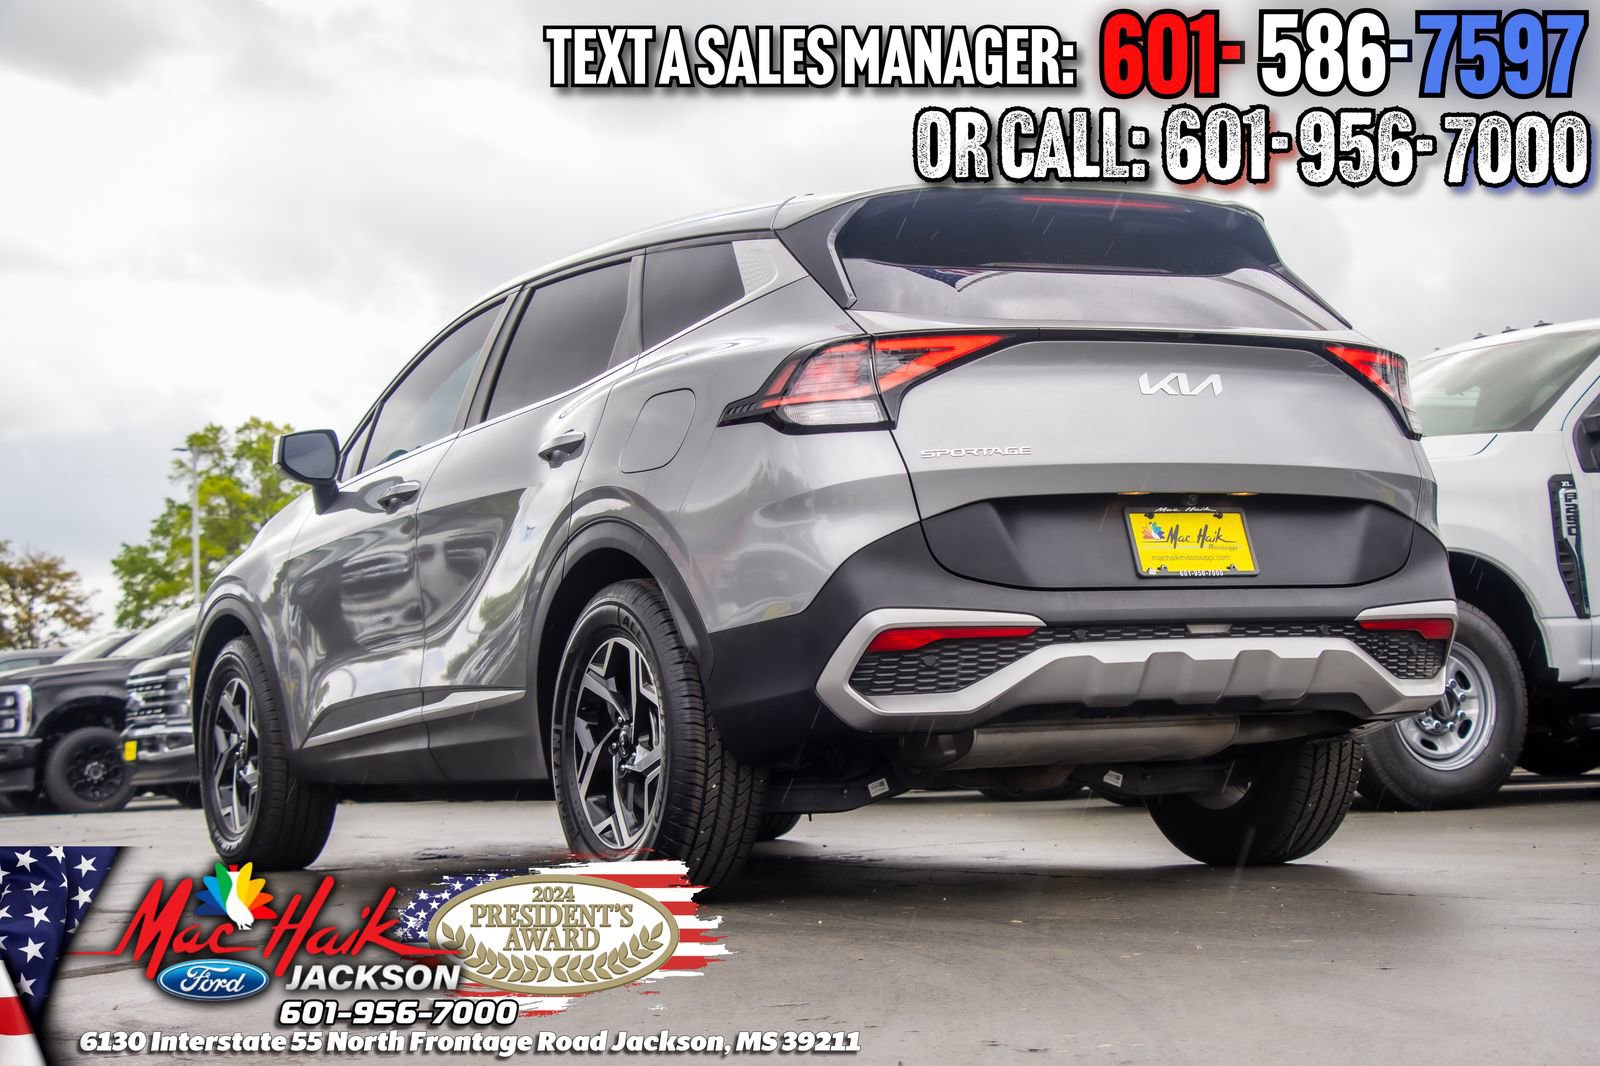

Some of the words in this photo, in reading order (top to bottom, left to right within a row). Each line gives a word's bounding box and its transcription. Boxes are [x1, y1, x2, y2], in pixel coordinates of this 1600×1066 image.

[1137, 372, 1224, 396] KIA
[920, 446, 1033, 459] SPORTAGE
[1166, 524, 1191, 549] Mac
[1197, 524, 1237, 549] Haik
